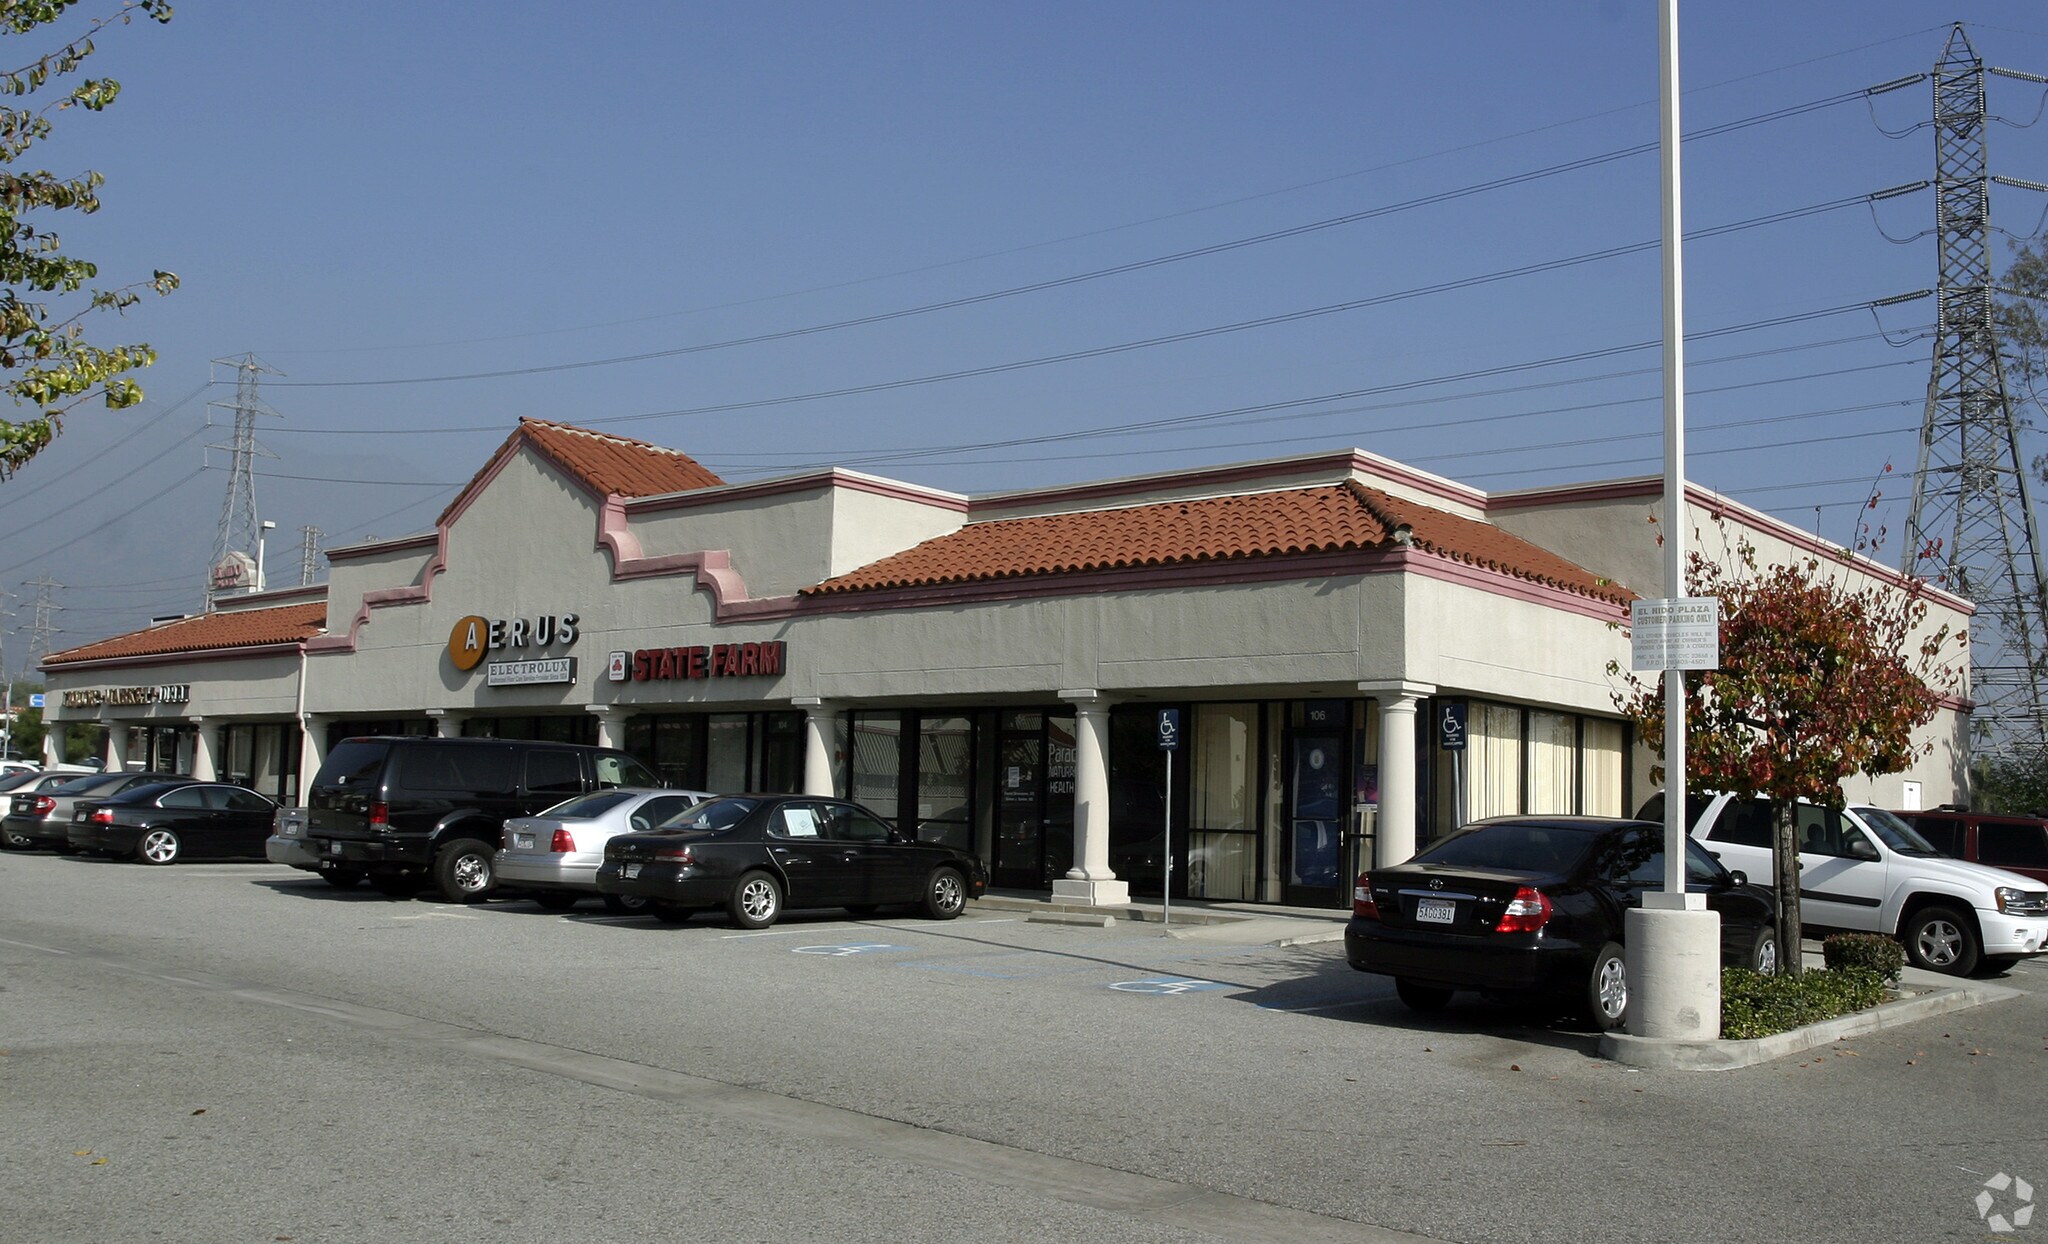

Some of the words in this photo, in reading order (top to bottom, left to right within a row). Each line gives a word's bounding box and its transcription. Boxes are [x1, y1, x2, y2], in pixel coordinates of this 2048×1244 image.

[1678, 605, 1710, 613] PLAZA
[1637, 616, 1667, 625] CUSTOMER
[1668, 615, 1694, 624] PARKING
[1696, 614, 1712, 623] ONLY
[465, 613, 579, 650] AERUS
[490, 660, 569, 676] ELECTROLUX
[633, 646, 708, 682] STATE
[711, 641, 784, 678] FARM
[1310, 710, 1326, 720] 106
[1049, 781, 1074, 794] HEALTH
